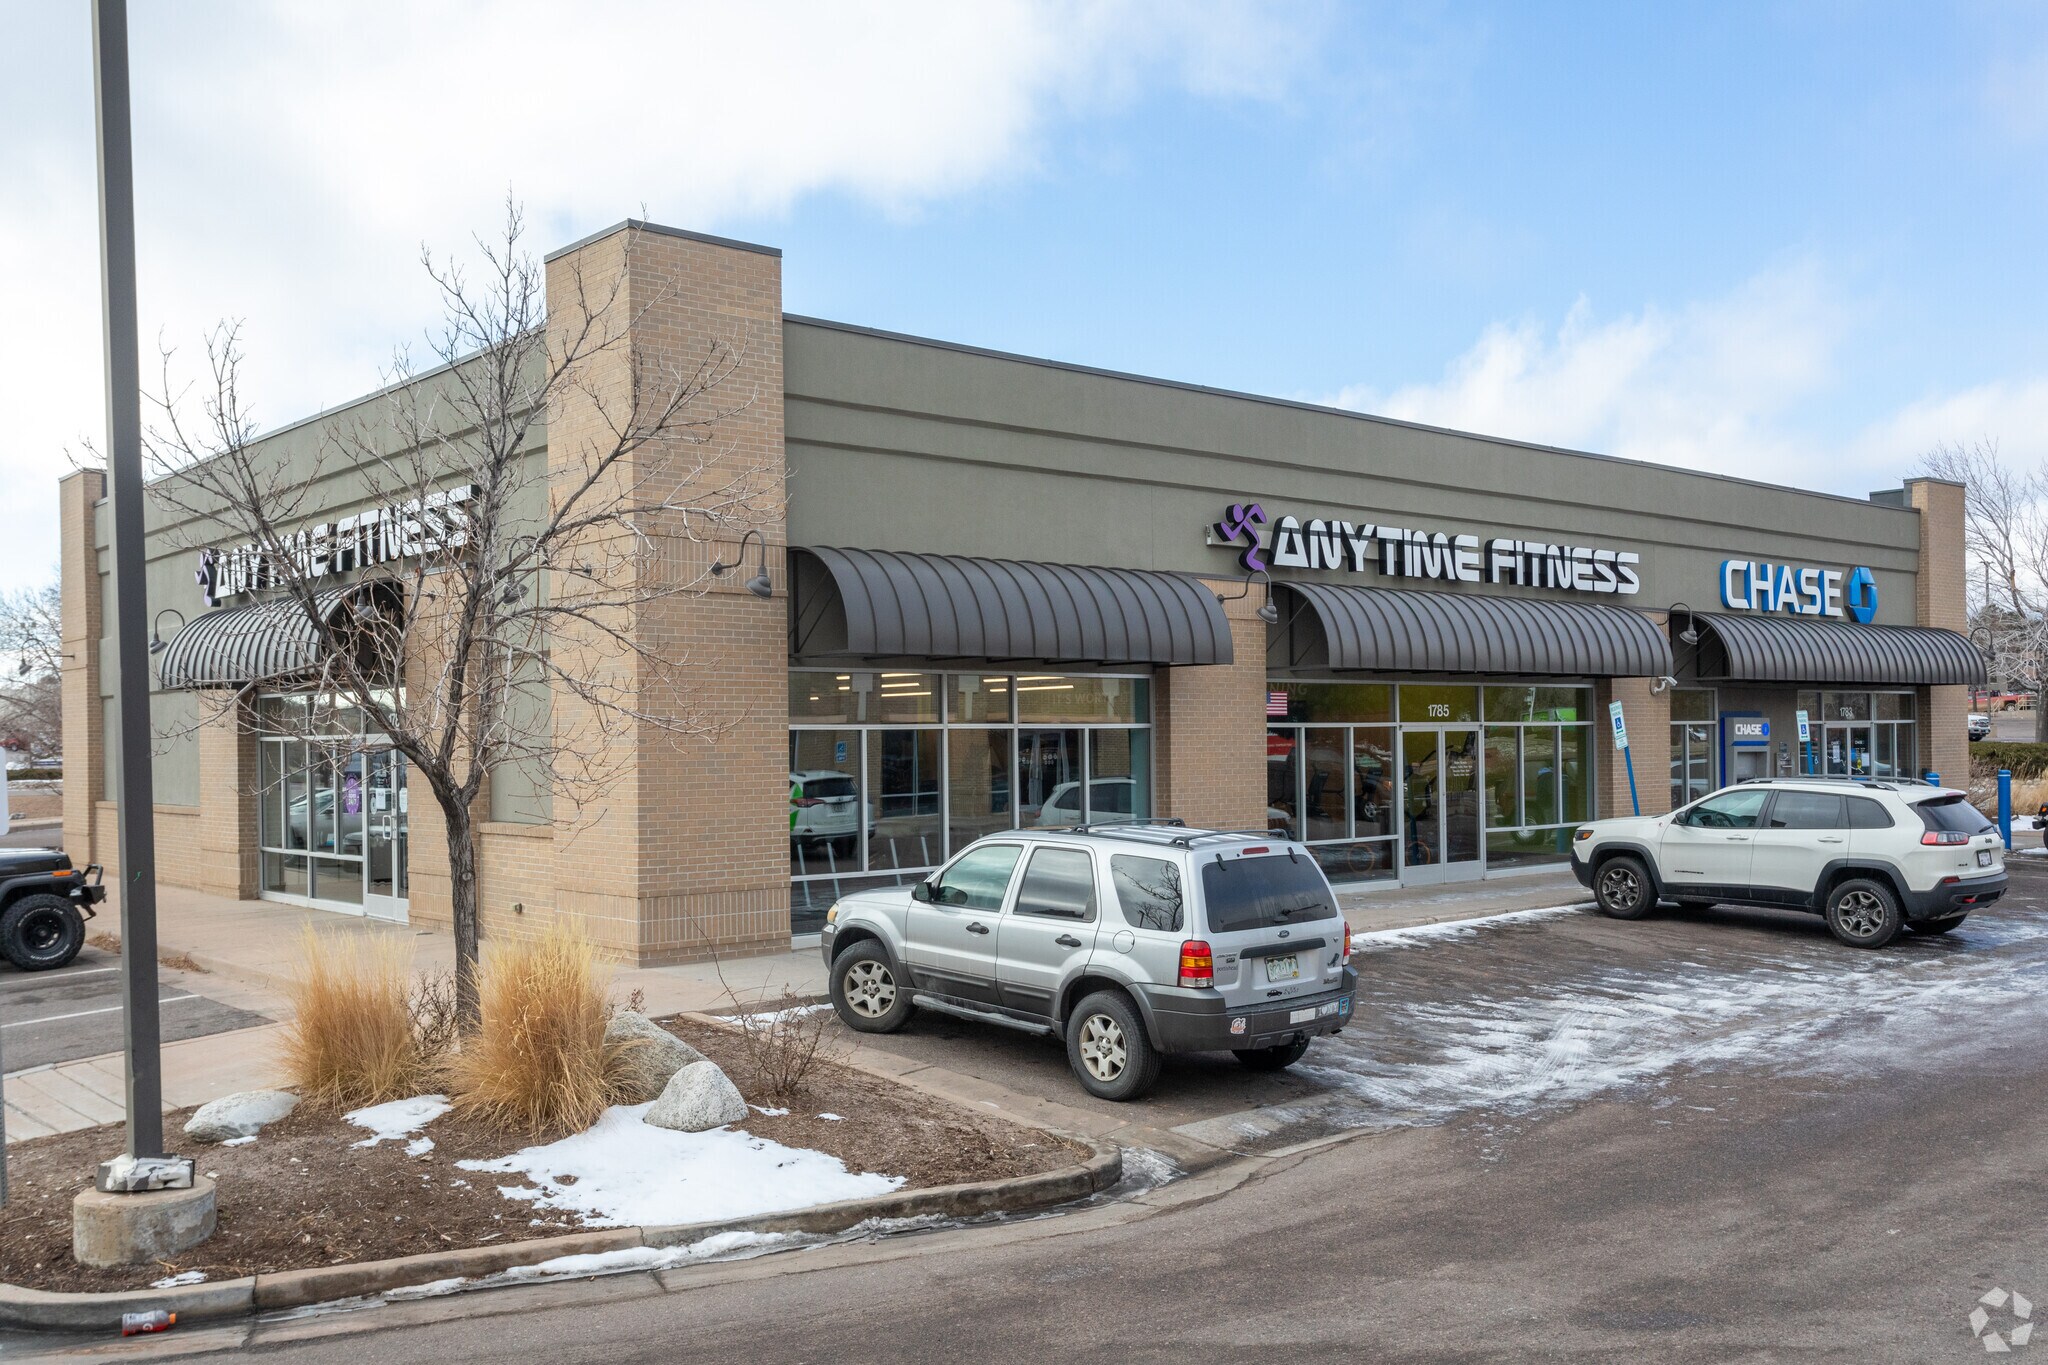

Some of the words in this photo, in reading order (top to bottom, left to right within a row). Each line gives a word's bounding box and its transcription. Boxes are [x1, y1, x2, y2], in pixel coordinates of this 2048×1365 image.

[337, 484, 473, 572] FITNESS
[1272, 515, 1481, 582] ANYTIME
[1486, 538, 1641, 594] FITNESS
[1721, 559, 1844, 617] CHASE
[1428, 704, 1450, 718] 1785
[1735, 723, 1762, 735] CHASE
